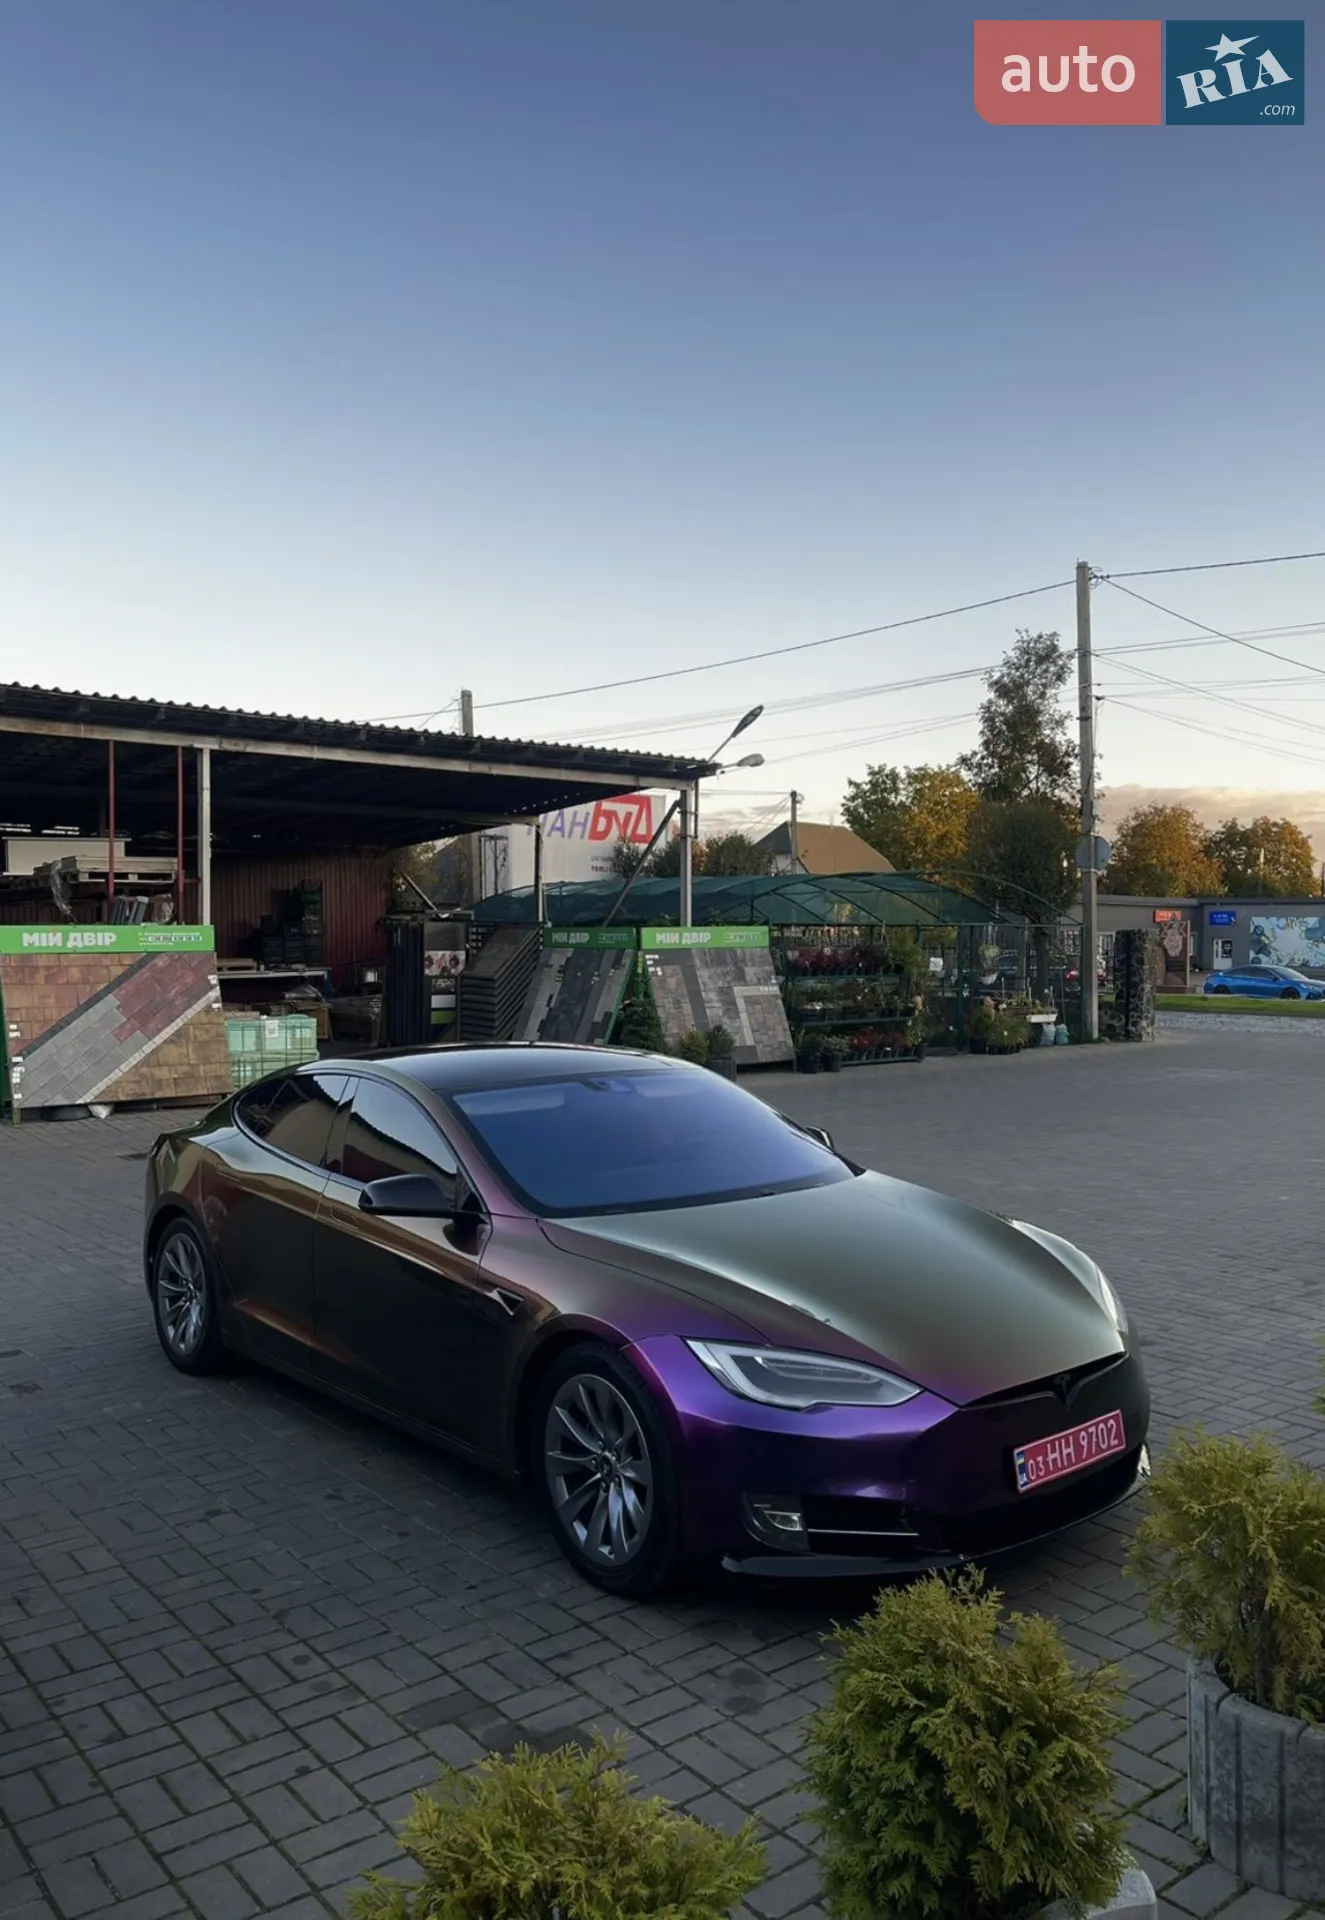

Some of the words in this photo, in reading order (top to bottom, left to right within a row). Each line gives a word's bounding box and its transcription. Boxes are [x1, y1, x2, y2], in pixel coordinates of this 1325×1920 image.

[22, 930, 63, 947] МІЙ
[66, 932, 117, 948] ДВІР
[655, 931, 680, 944] МІЙ
[681, 932, 711, 945] ДВІР
[1028, 1456, 1045, 1480] 03
[1047, 1436, 1076, 1471] HH
[1079, 1419, 1119, 1459] 9702
